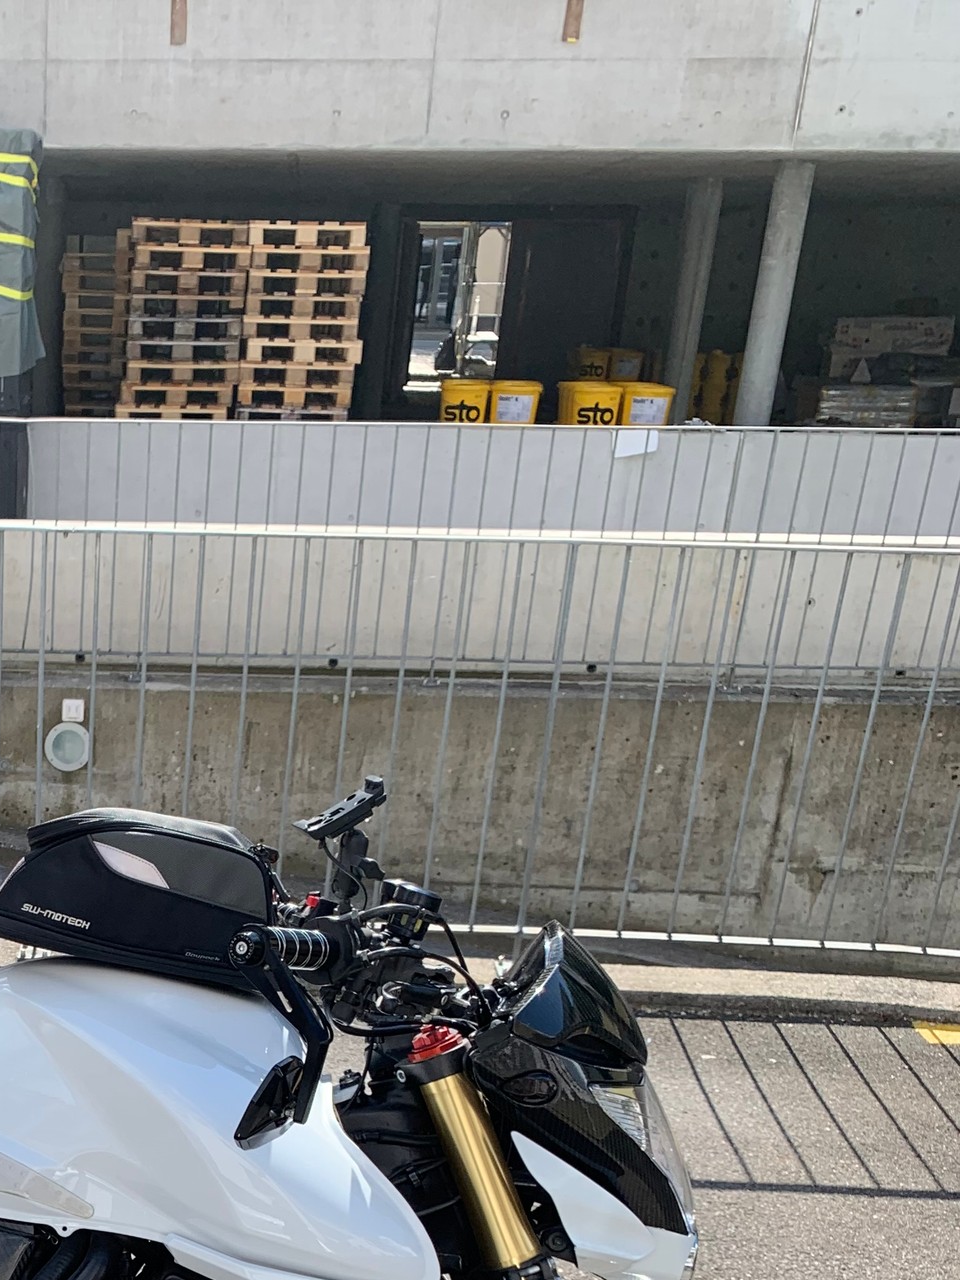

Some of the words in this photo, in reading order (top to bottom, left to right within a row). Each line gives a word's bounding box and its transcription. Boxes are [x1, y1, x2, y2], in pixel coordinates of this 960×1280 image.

[579, 362, 605, 377] sto
[444, 399, 481, 423] sto
[577, 402, 614, 425] sto
[21, 903, 91, 930] SW-MOTECH
